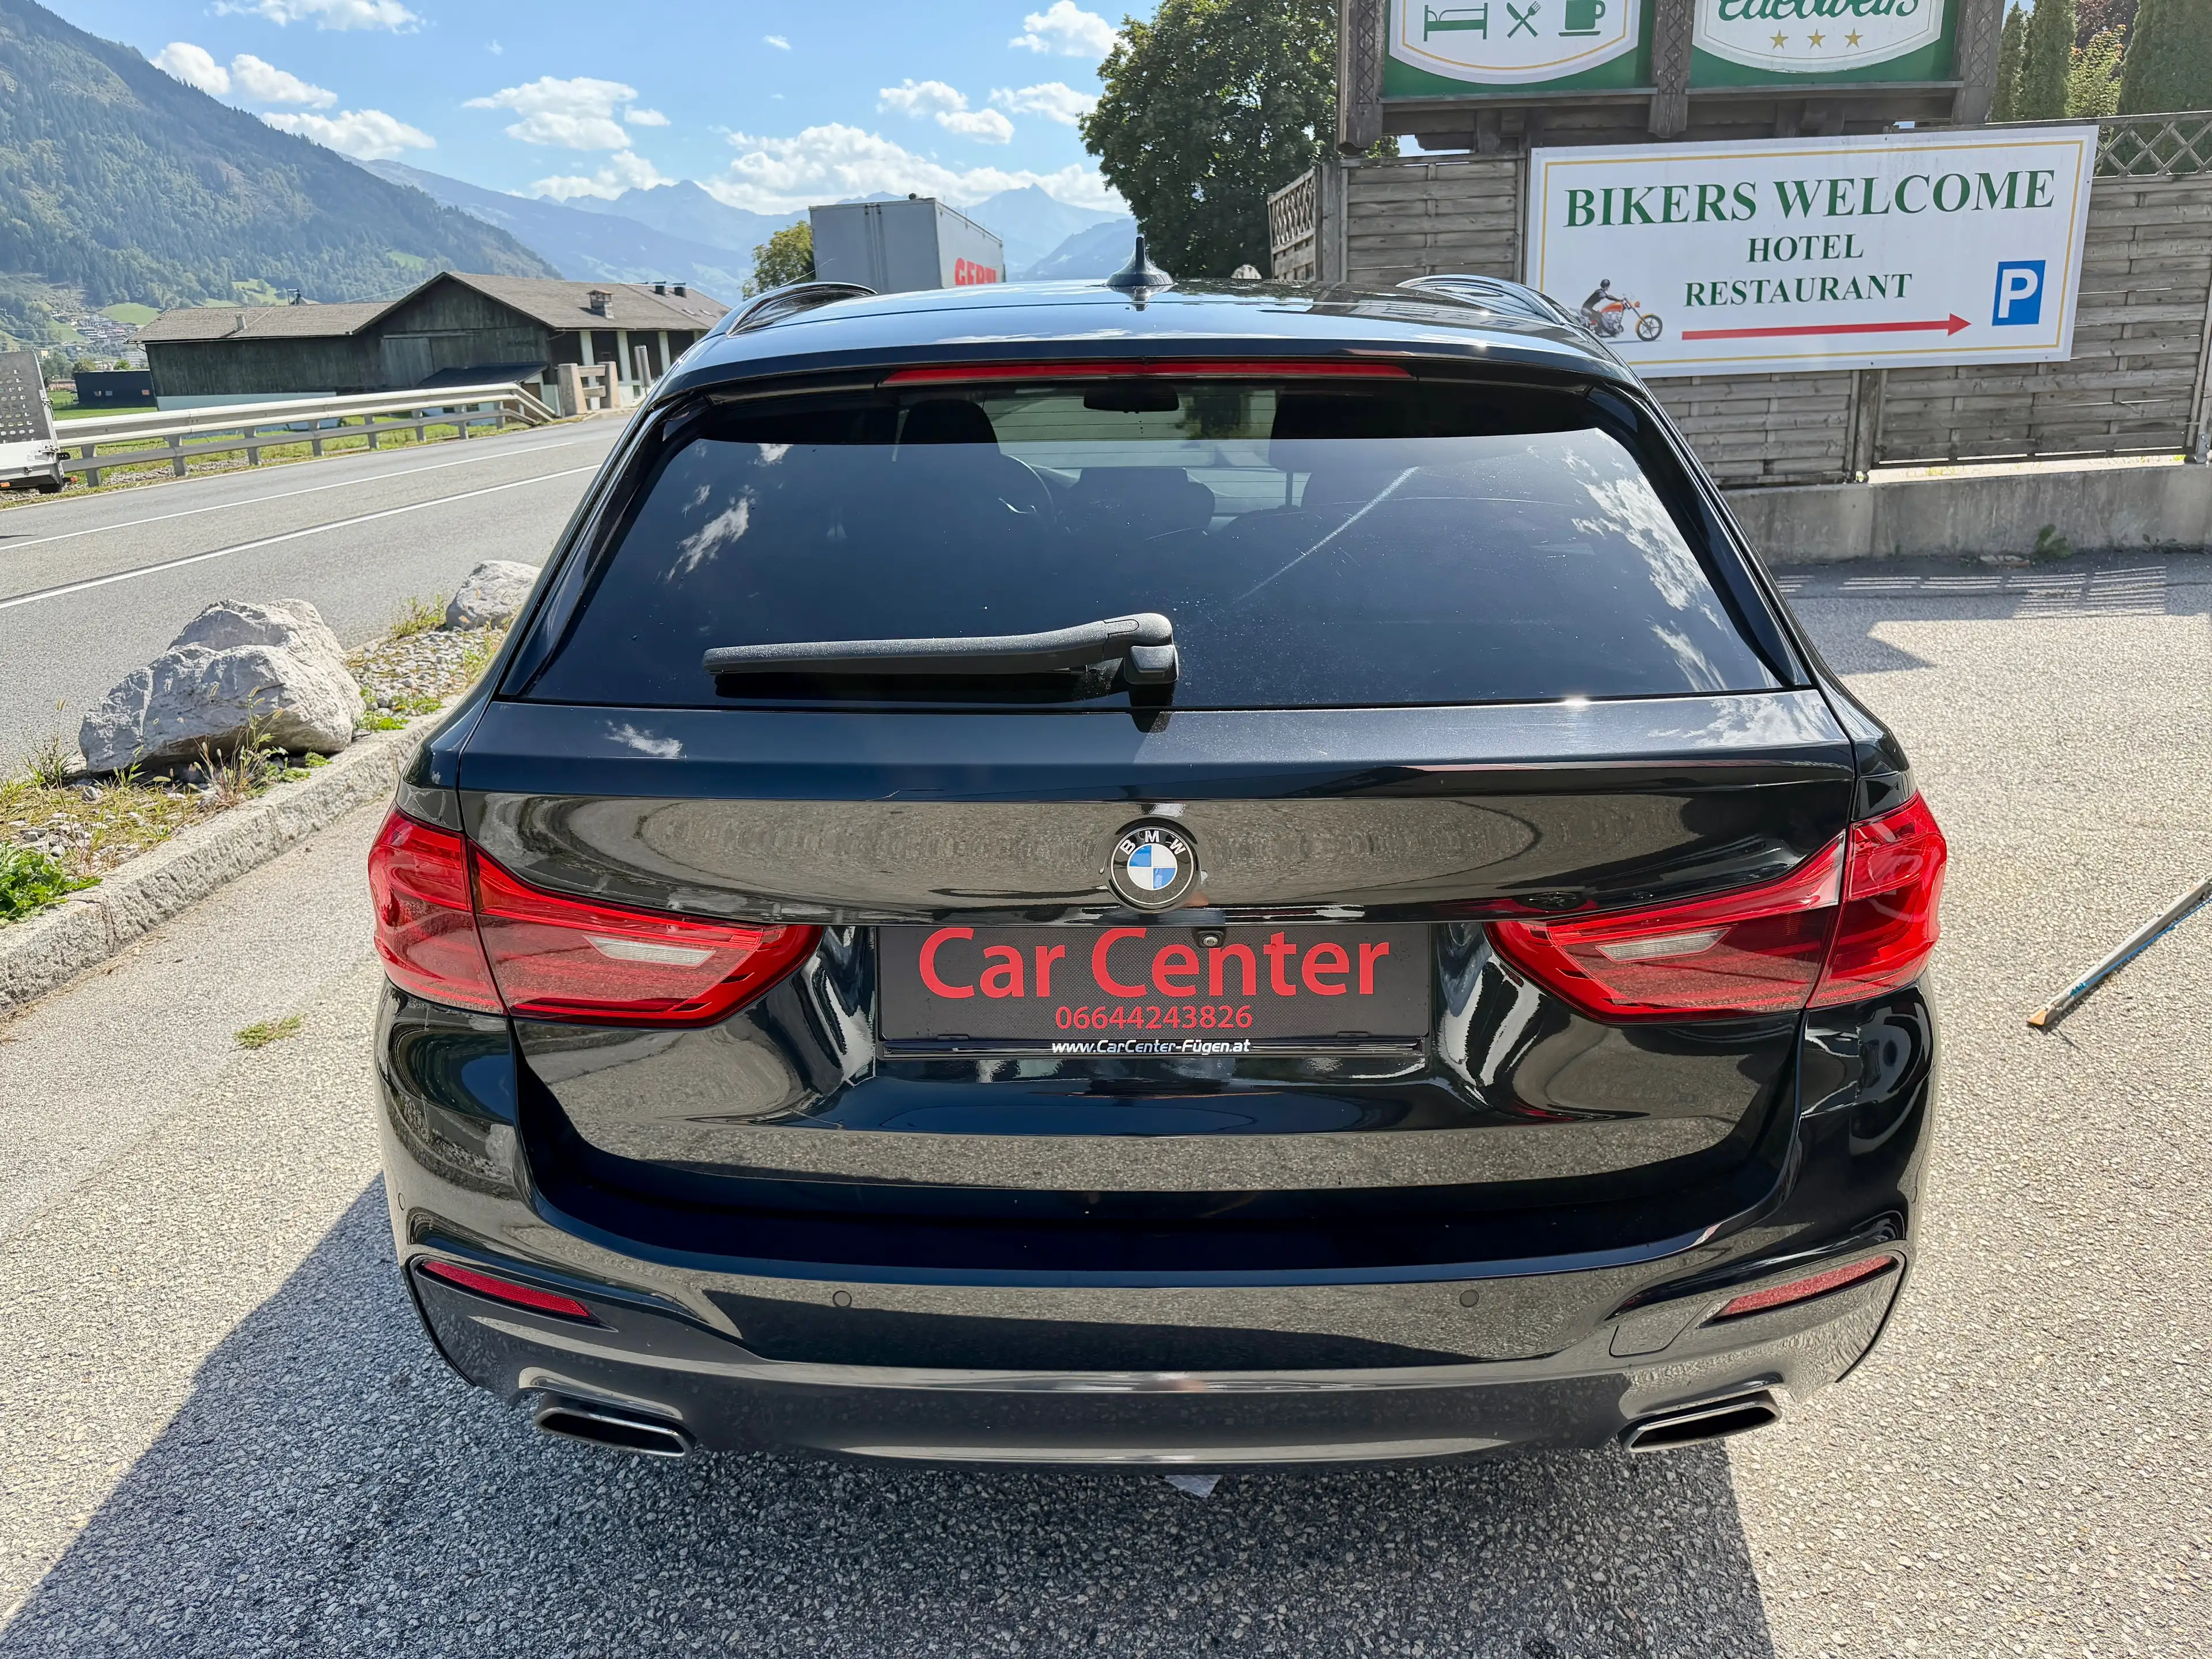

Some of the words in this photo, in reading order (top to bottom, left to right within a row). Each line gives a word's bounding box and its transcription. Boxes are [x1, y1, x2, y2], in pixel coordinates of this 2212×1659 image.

[1564, 181, 1756, 228] BIKERS
[1772, 170, 2055, 219] WELCOME
[1746, 234, 1864, 263] HOTEL
[1683, 273, 1912, 308] RESTAURANT
[1997, 268, 2039, 319] P
[1119, 830, 1187, 855] BMW
[919, 927, 1066, 999] Car
[1092, 926, 1390, 998] Center
[1055, 1005, 1253, 1029] 06644243826
[1052, 1039, 1251, 1056] www.CarCenter-Fügen.at
